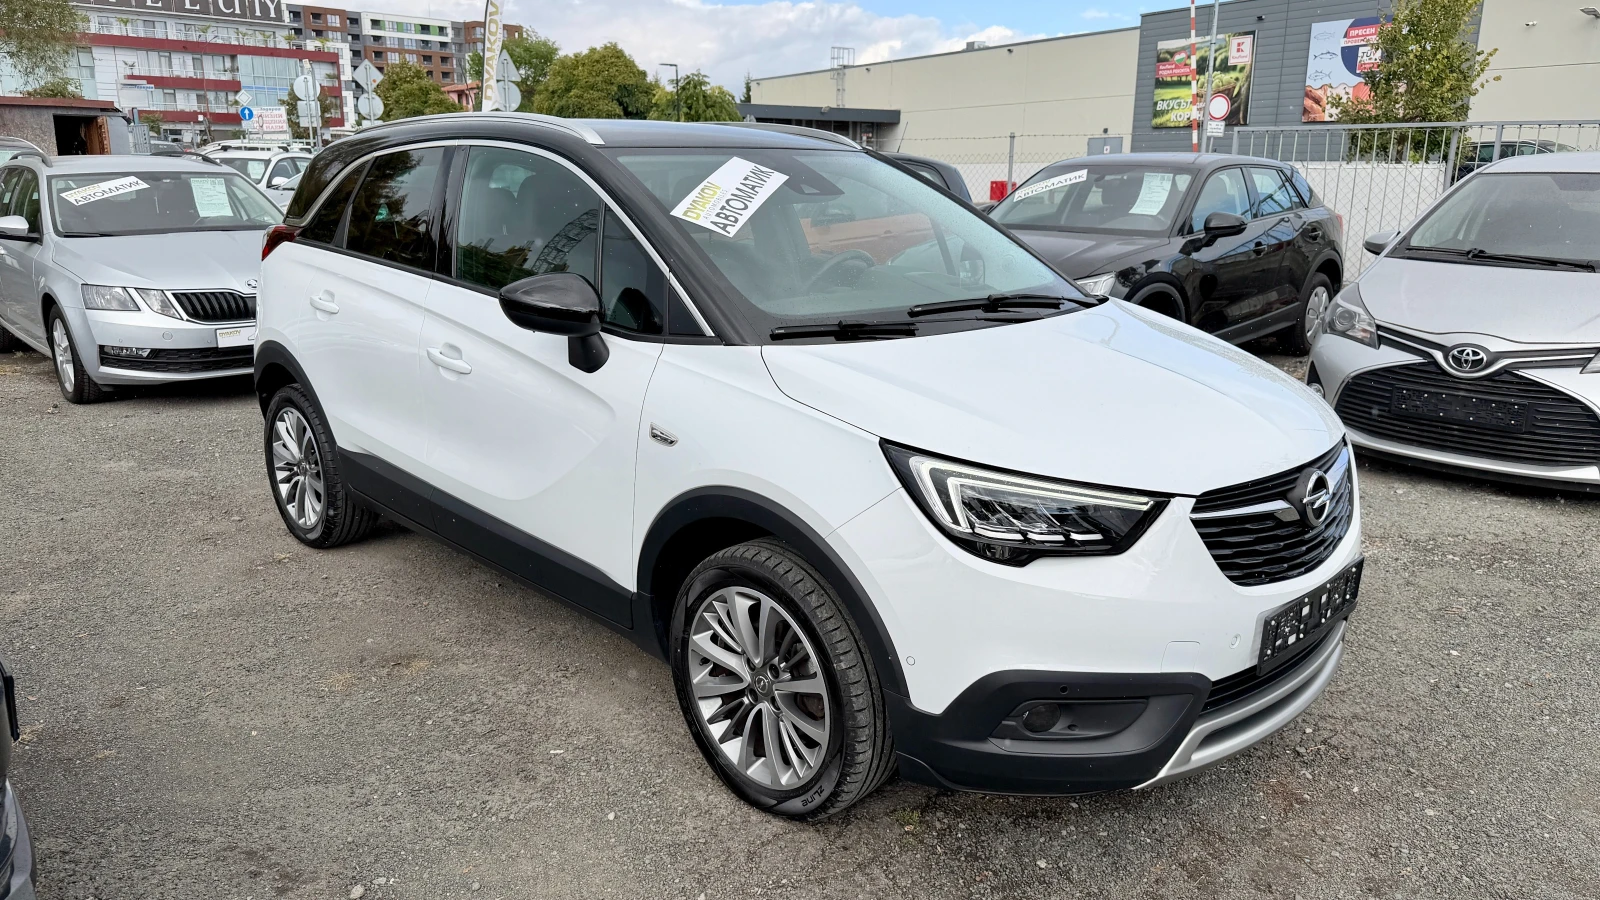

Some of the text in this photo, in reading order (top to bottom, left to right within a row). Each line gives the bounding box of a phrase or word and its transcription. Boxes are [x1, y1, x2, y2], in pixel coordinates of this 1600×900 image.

[1350, 28, 1375, 36] ПРЕСЕН
[484, 0, 500, 101] DYAKOV
[1156, 99, 1192, 111] ВКУСЪТ
[74, 180, 145, 205] АВТОМАТИК
[710, 165, 775, 234] АВТОМАТИК
[1016, 173, 1085, 200] АВТОМАТИК
[682, 181, 721, 221] DYAKOV
